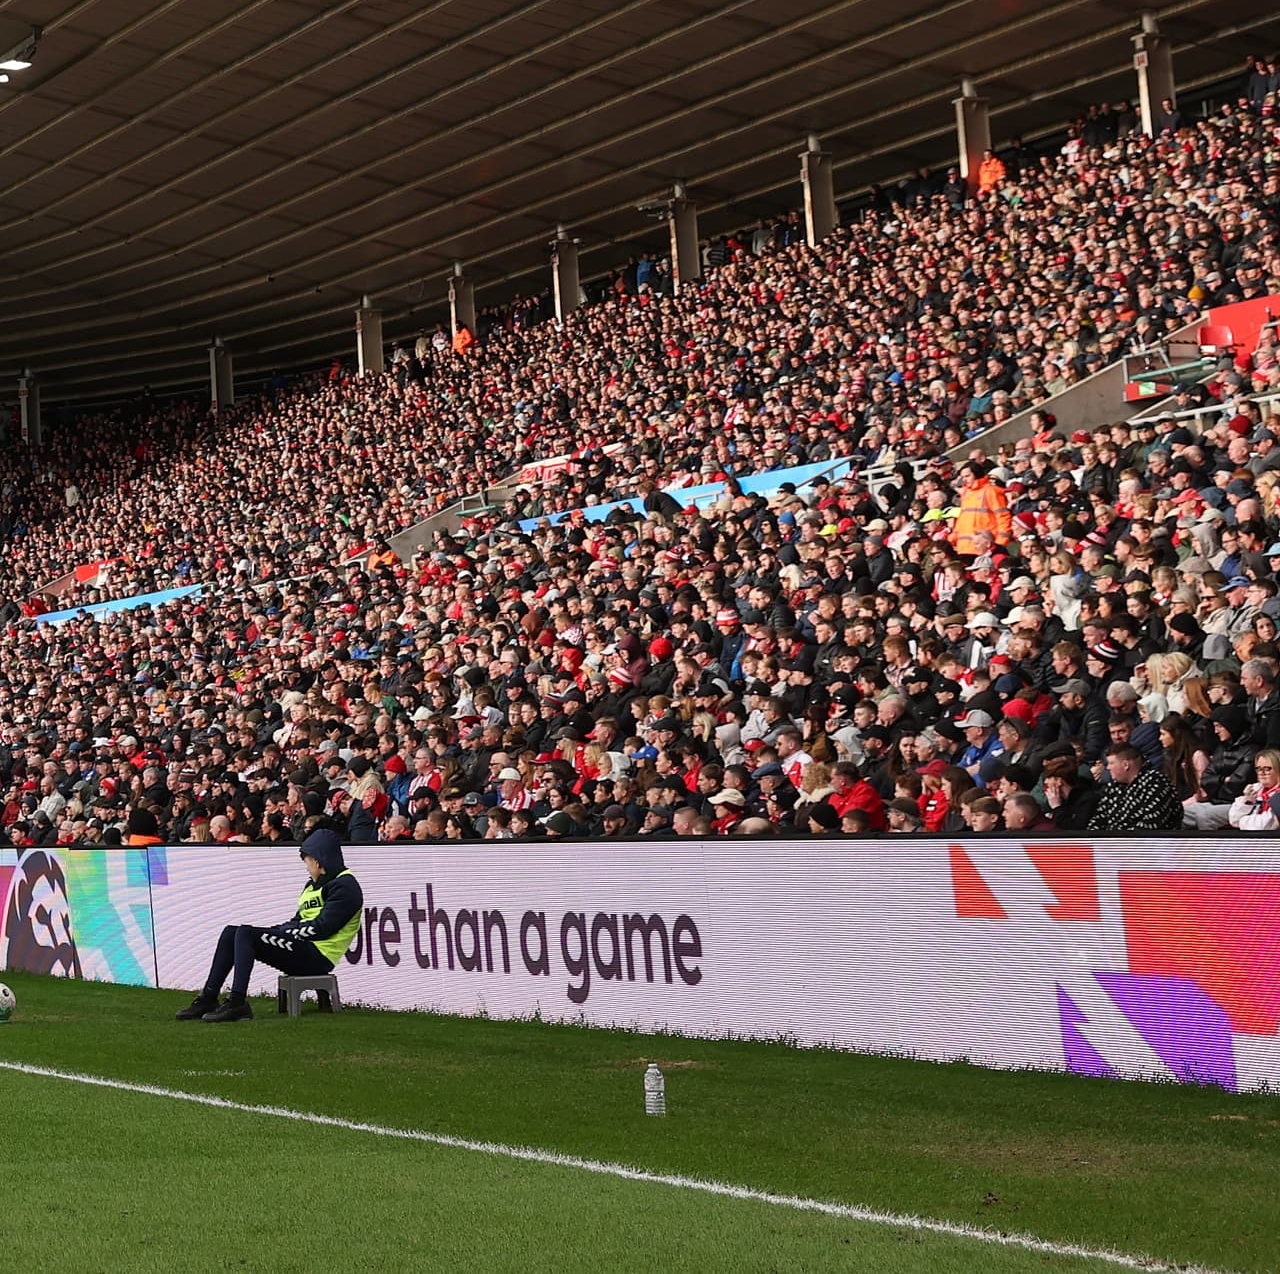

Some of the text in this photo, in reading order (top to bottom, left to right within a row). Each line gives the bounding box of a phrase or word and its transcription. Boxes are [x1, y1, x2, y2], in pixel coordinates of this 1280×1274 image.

[345, 883, 704, 1005] ore than a game
